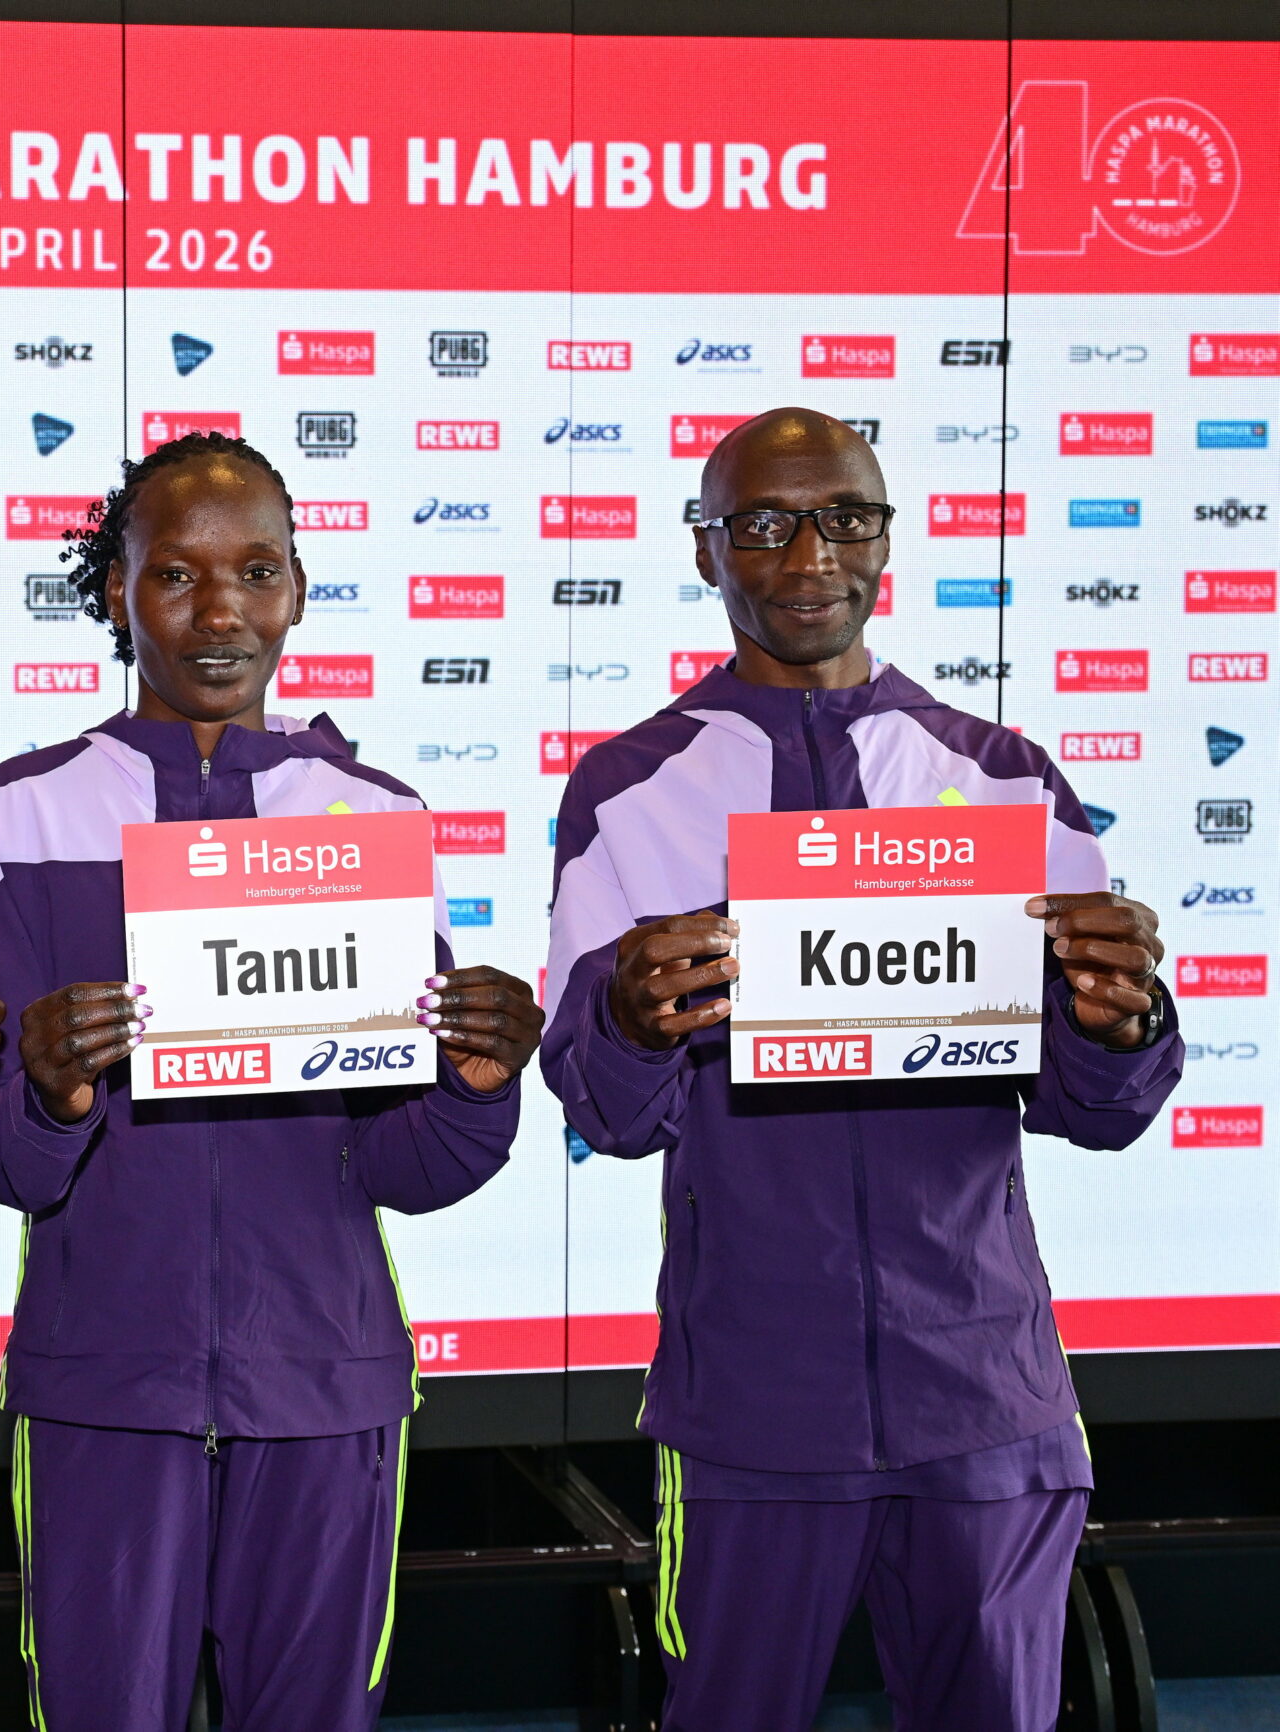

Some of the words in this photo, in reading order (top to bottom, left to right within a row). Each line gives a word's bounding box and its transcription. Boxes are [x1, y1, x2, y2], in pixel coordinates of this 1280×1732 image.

[1106, 124, 1145, 183] HASPA
[1146, 115, 1224, 184] MARATHON
[408, 137, 828, 209] HAMBURG
[1126, 210, 1204, 238] HAMBURG
[146, 230, 274, 272] 2026
[14, 344, 93, 360] SHOKZ
[309, 341, 371, 363] Haspa
[438, 338, 481, 360] PUBG
[551, 345, 628, 368] REWE
[832, 346, 891, 367] Haspa
[940, 341, 1011, 366] ESN
[1070, 345, 1148, 362] BYD
[1219, 343, 1278, 366] Haspa
[305, 419, 348, 441] PUBG
[420, 424, 496, 447] REWE
[935, 425, 1020, 442] BYD
[1090, 424, 1149, 445] Haspa
[293, 505, 364, 528] REWE
[572, 506, 632, 528] Haspa
[958, 505, 1020, 526] Haspa
[1195, 505, 1268, 521] SHOKZ
[439, 585, 499, 607] Haspa
[552, 579, 621, 605] ESN
[1066, 585, 1139, 601] SHOKZ
[1214, 581, 1273, 602] Haspa
[19, 667, 96, 690] REWE
[309, 665, 368, 687] Haspa
[422, 658, 490, 684] ESN
[547, 664, 630, 681] BYD
[934, 663, 1012, 680] SHOKZ
[1086, 661, 1144, 682] Haspa
[1192, 657, 1264, 678] REWE
[417, 745, 498, 761] BYD
[1064, 736, 1137, 758] REWE
[1204, 806, 1245, 828] PUBG
[441, 822, 501, 843] Haspa
[243, 840, 361, 879] Haspa
[854, 832, 975, 872] Haspa
[245, 886, 306, 898] Hamburger
[308, 884, 362, 896] Sparkasse
[854, 878, 915, 890] Hamburger
[918, 877, 974, 889] Sparkasse
[202, 932, 358, 996] Tanui
[800, 927, 976, 986] Koech
[1205, 967, 1263, 986] Haspa
[235, 1028, 256, 1037] HASPA
[258, 1026, 296, 1036] MARATHON
[297, 1025, 330, 1034] HAMBURG
[332, 1024, 348, 1032] 2026
[823, 1020, 835, 1028] 40.
[836, 1020, 859, 1028] HASPA
[860, 1019, 899, 1028] MARATHON
[900, 1018, 934, 1027] HAMBURG
[936, 1017, 952, 1025] 2026
[159, 1049, 264, 1083] REWE
[759, 1041, 866, 1072] REWE
[1202, 1117, 1259, 1136] Haspa
